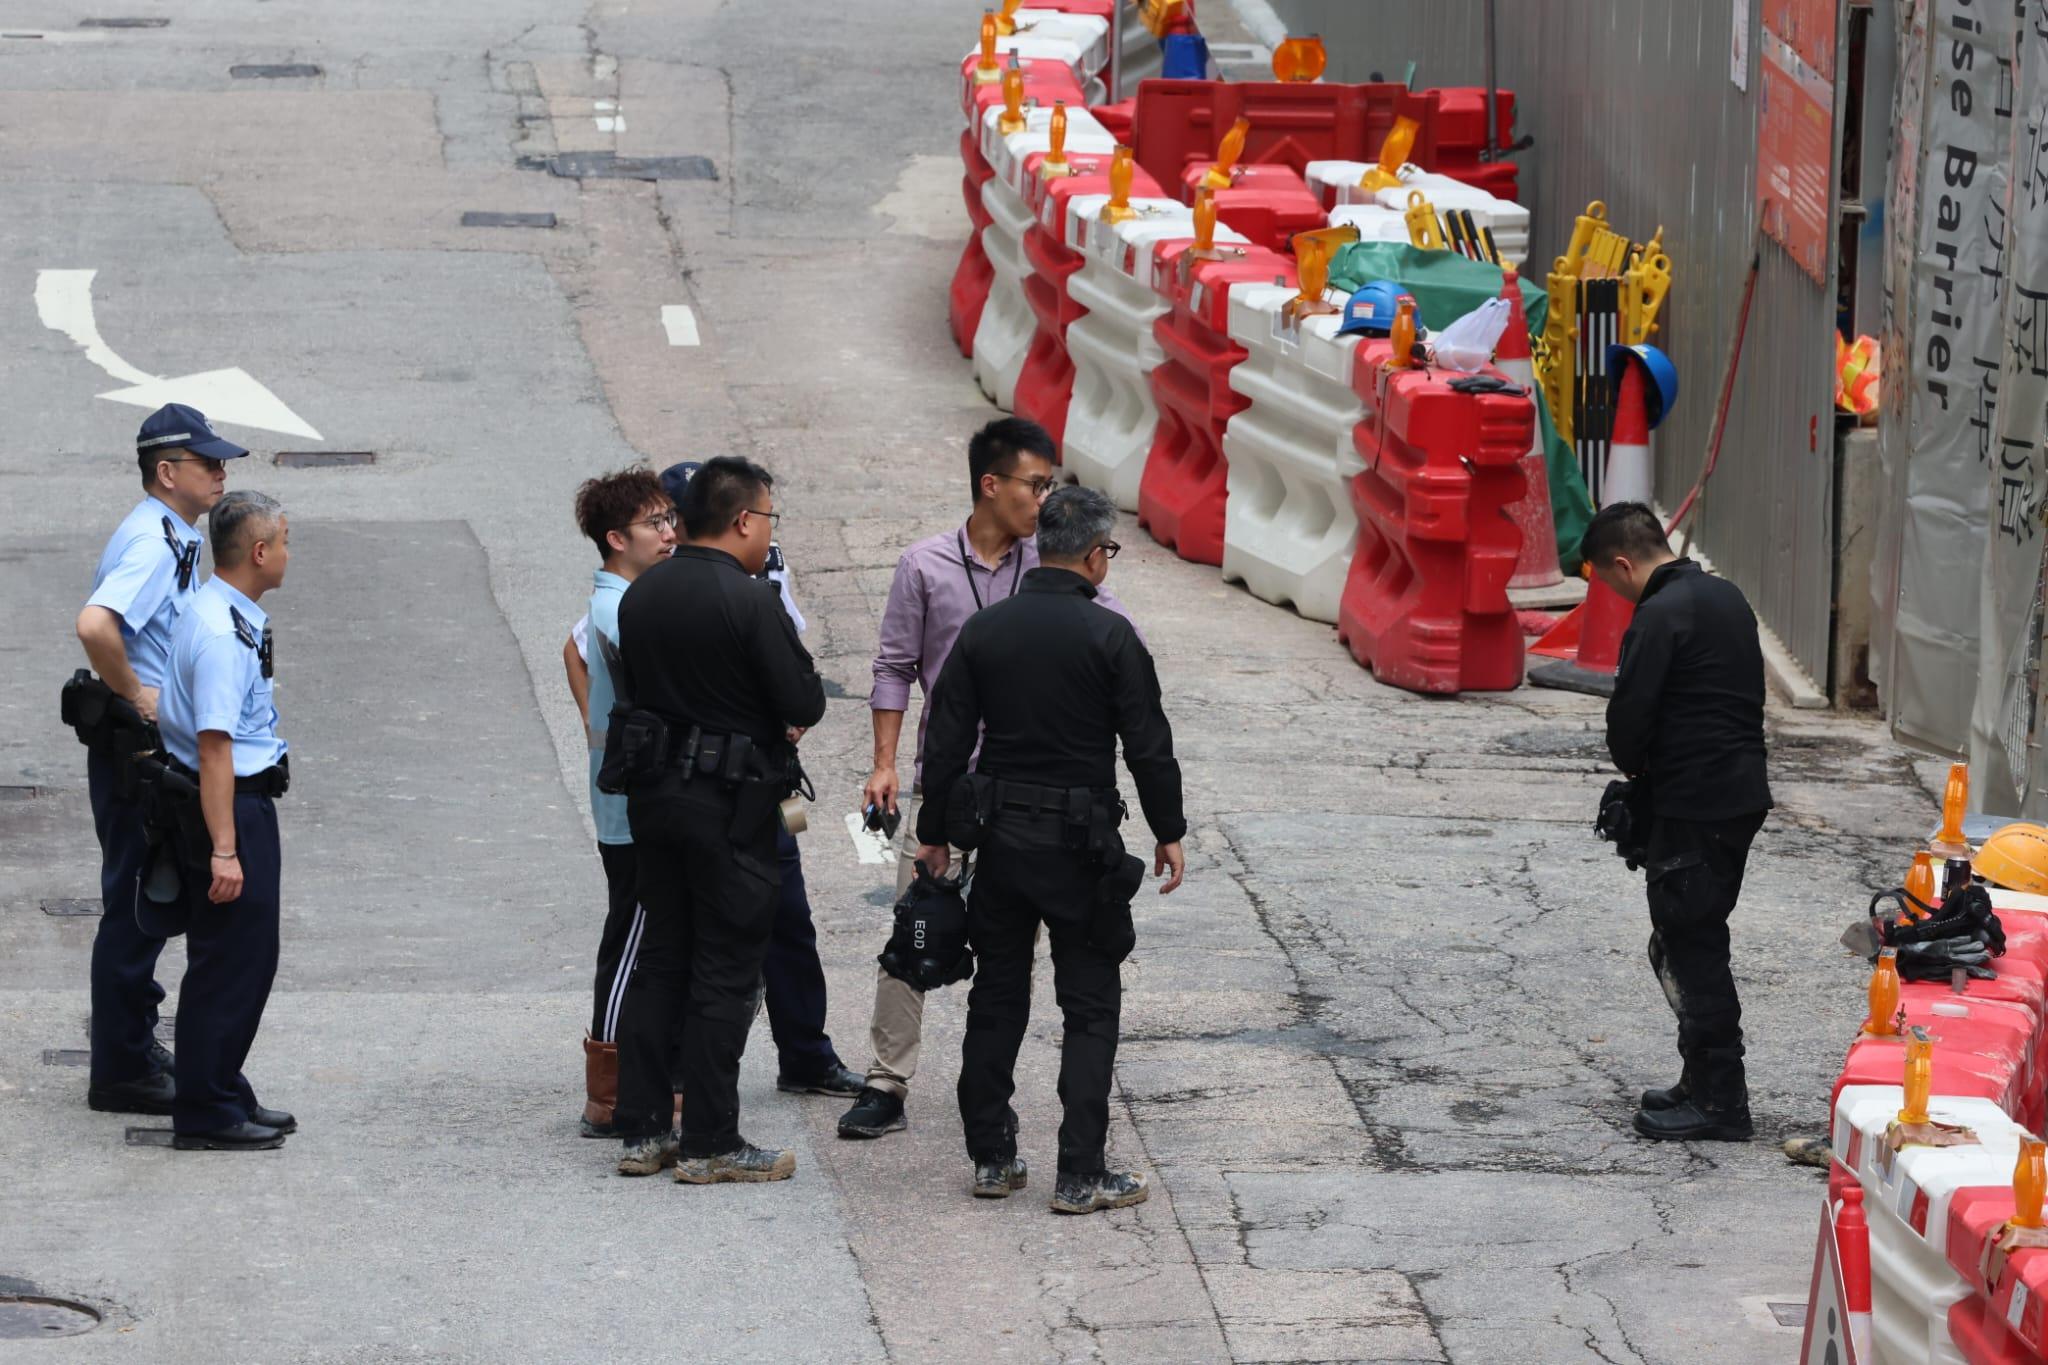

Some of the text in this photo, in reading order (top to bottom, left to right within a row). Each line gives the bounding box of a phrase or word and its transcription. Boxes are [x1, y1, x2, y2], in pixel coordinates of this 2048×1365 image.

[1927, 0, 1982, 411] ise Barrier
[914, 920, 926, 949] EOD
